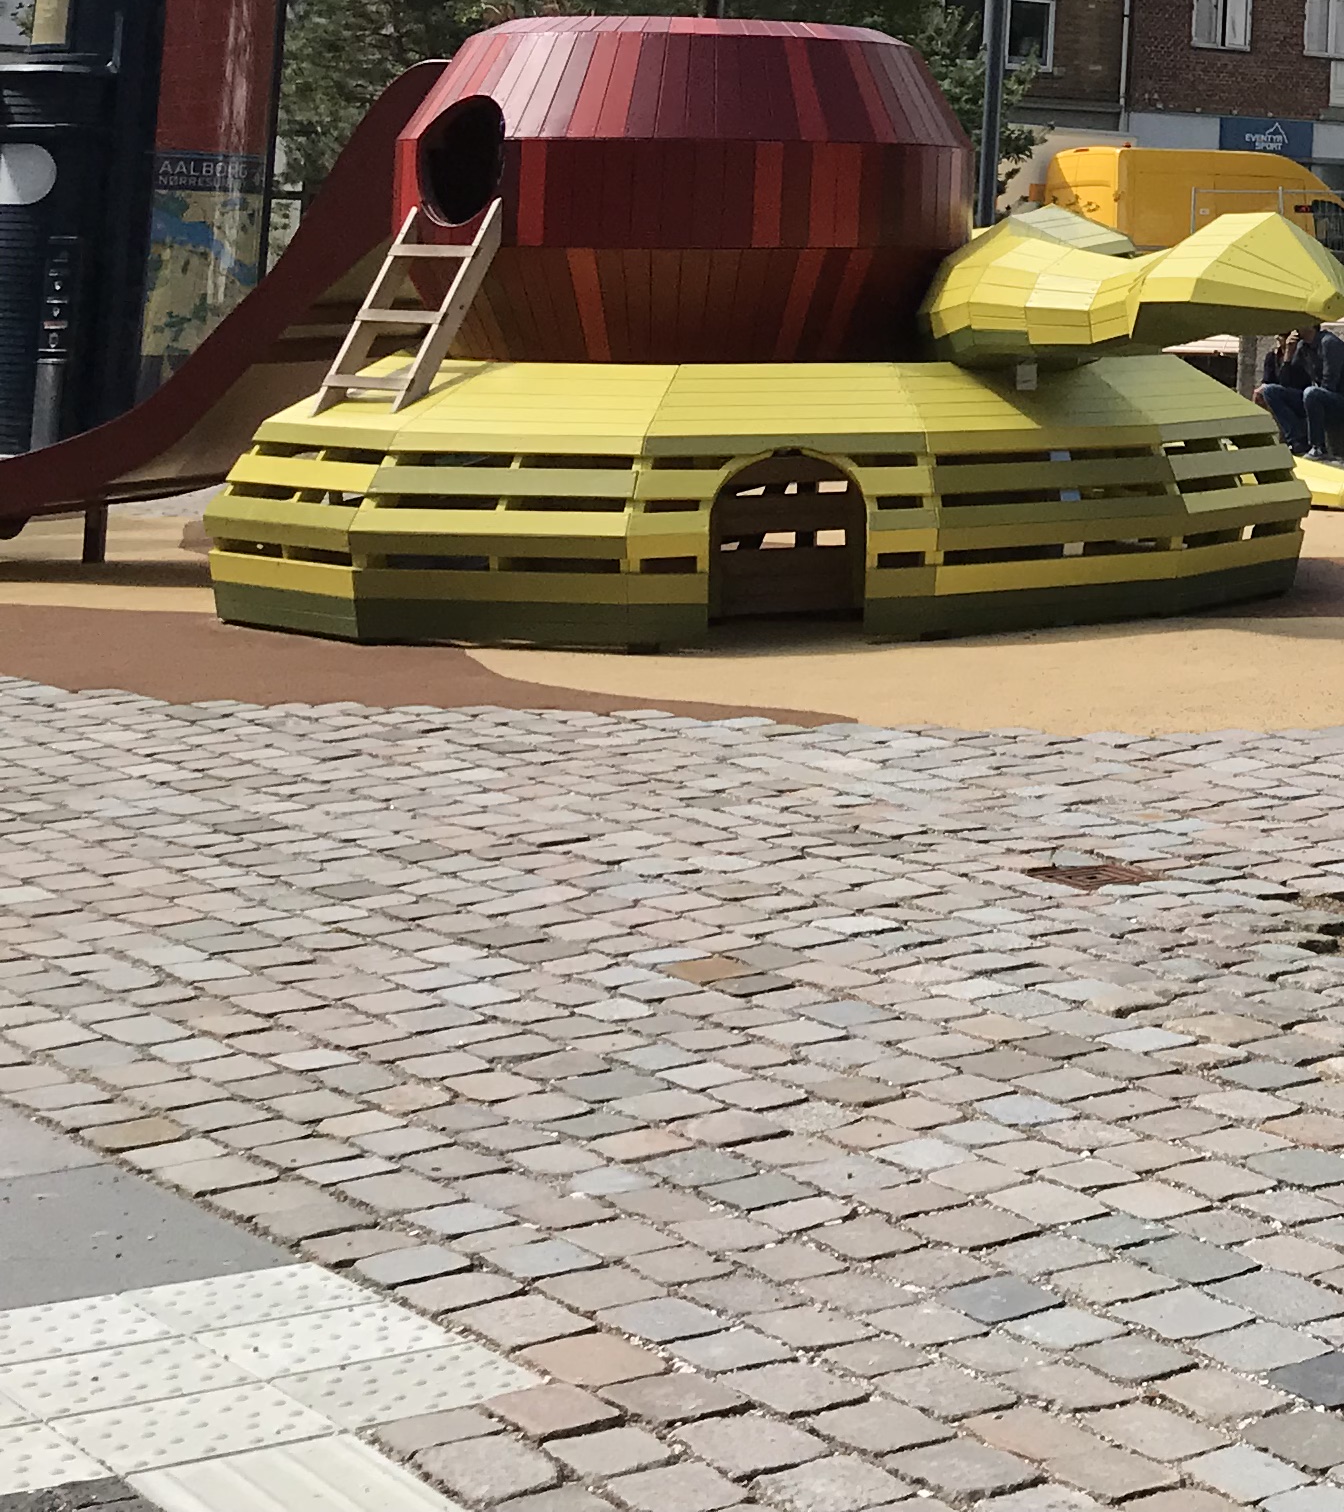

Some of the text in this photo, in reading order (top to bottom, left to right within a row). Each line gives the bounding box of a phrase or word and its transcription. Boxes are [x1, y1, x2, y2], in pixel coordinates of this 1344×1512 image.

[1245, 133, 1283, 142] EVENTYR
[1255, 142, 1283, 150] SPORT
[159, 160, 248, 178] AALBORG
